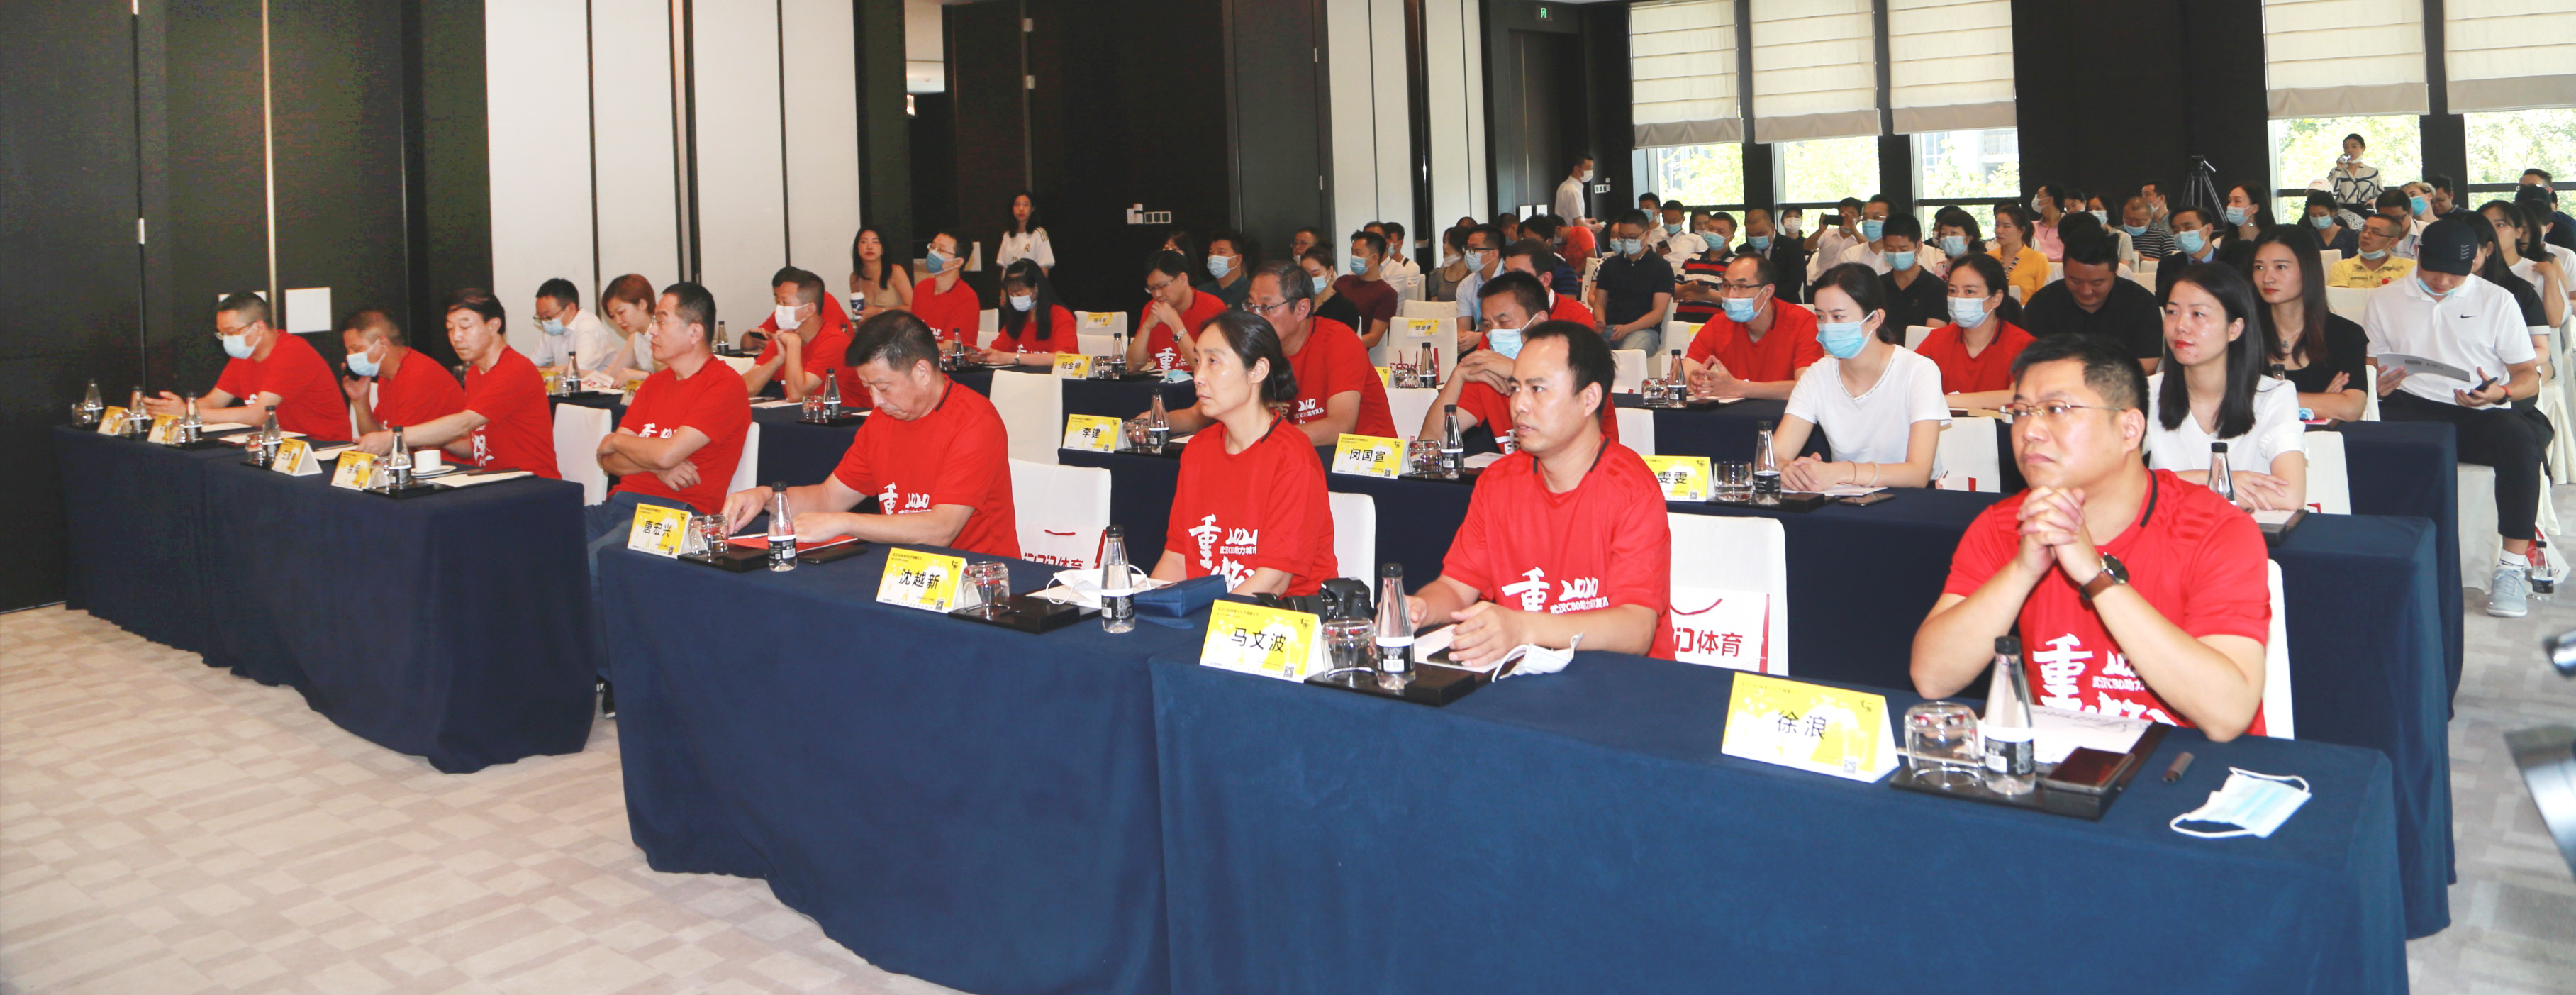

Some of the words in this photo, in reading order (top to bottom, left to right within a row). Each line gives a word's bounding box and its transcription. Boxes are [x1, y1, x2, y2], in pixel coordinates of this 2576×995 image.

[1082, 428, 1100, 438] 李建
[1350, 448, 1385, 462] 闵国宣
[643, 520, 672, 538] 唐宏兴
[898, 568, 940, 589] 沈越新
[1231, 627, 1286, 653] 马文波
[1778, 710, 1826, 740] 徐浪
